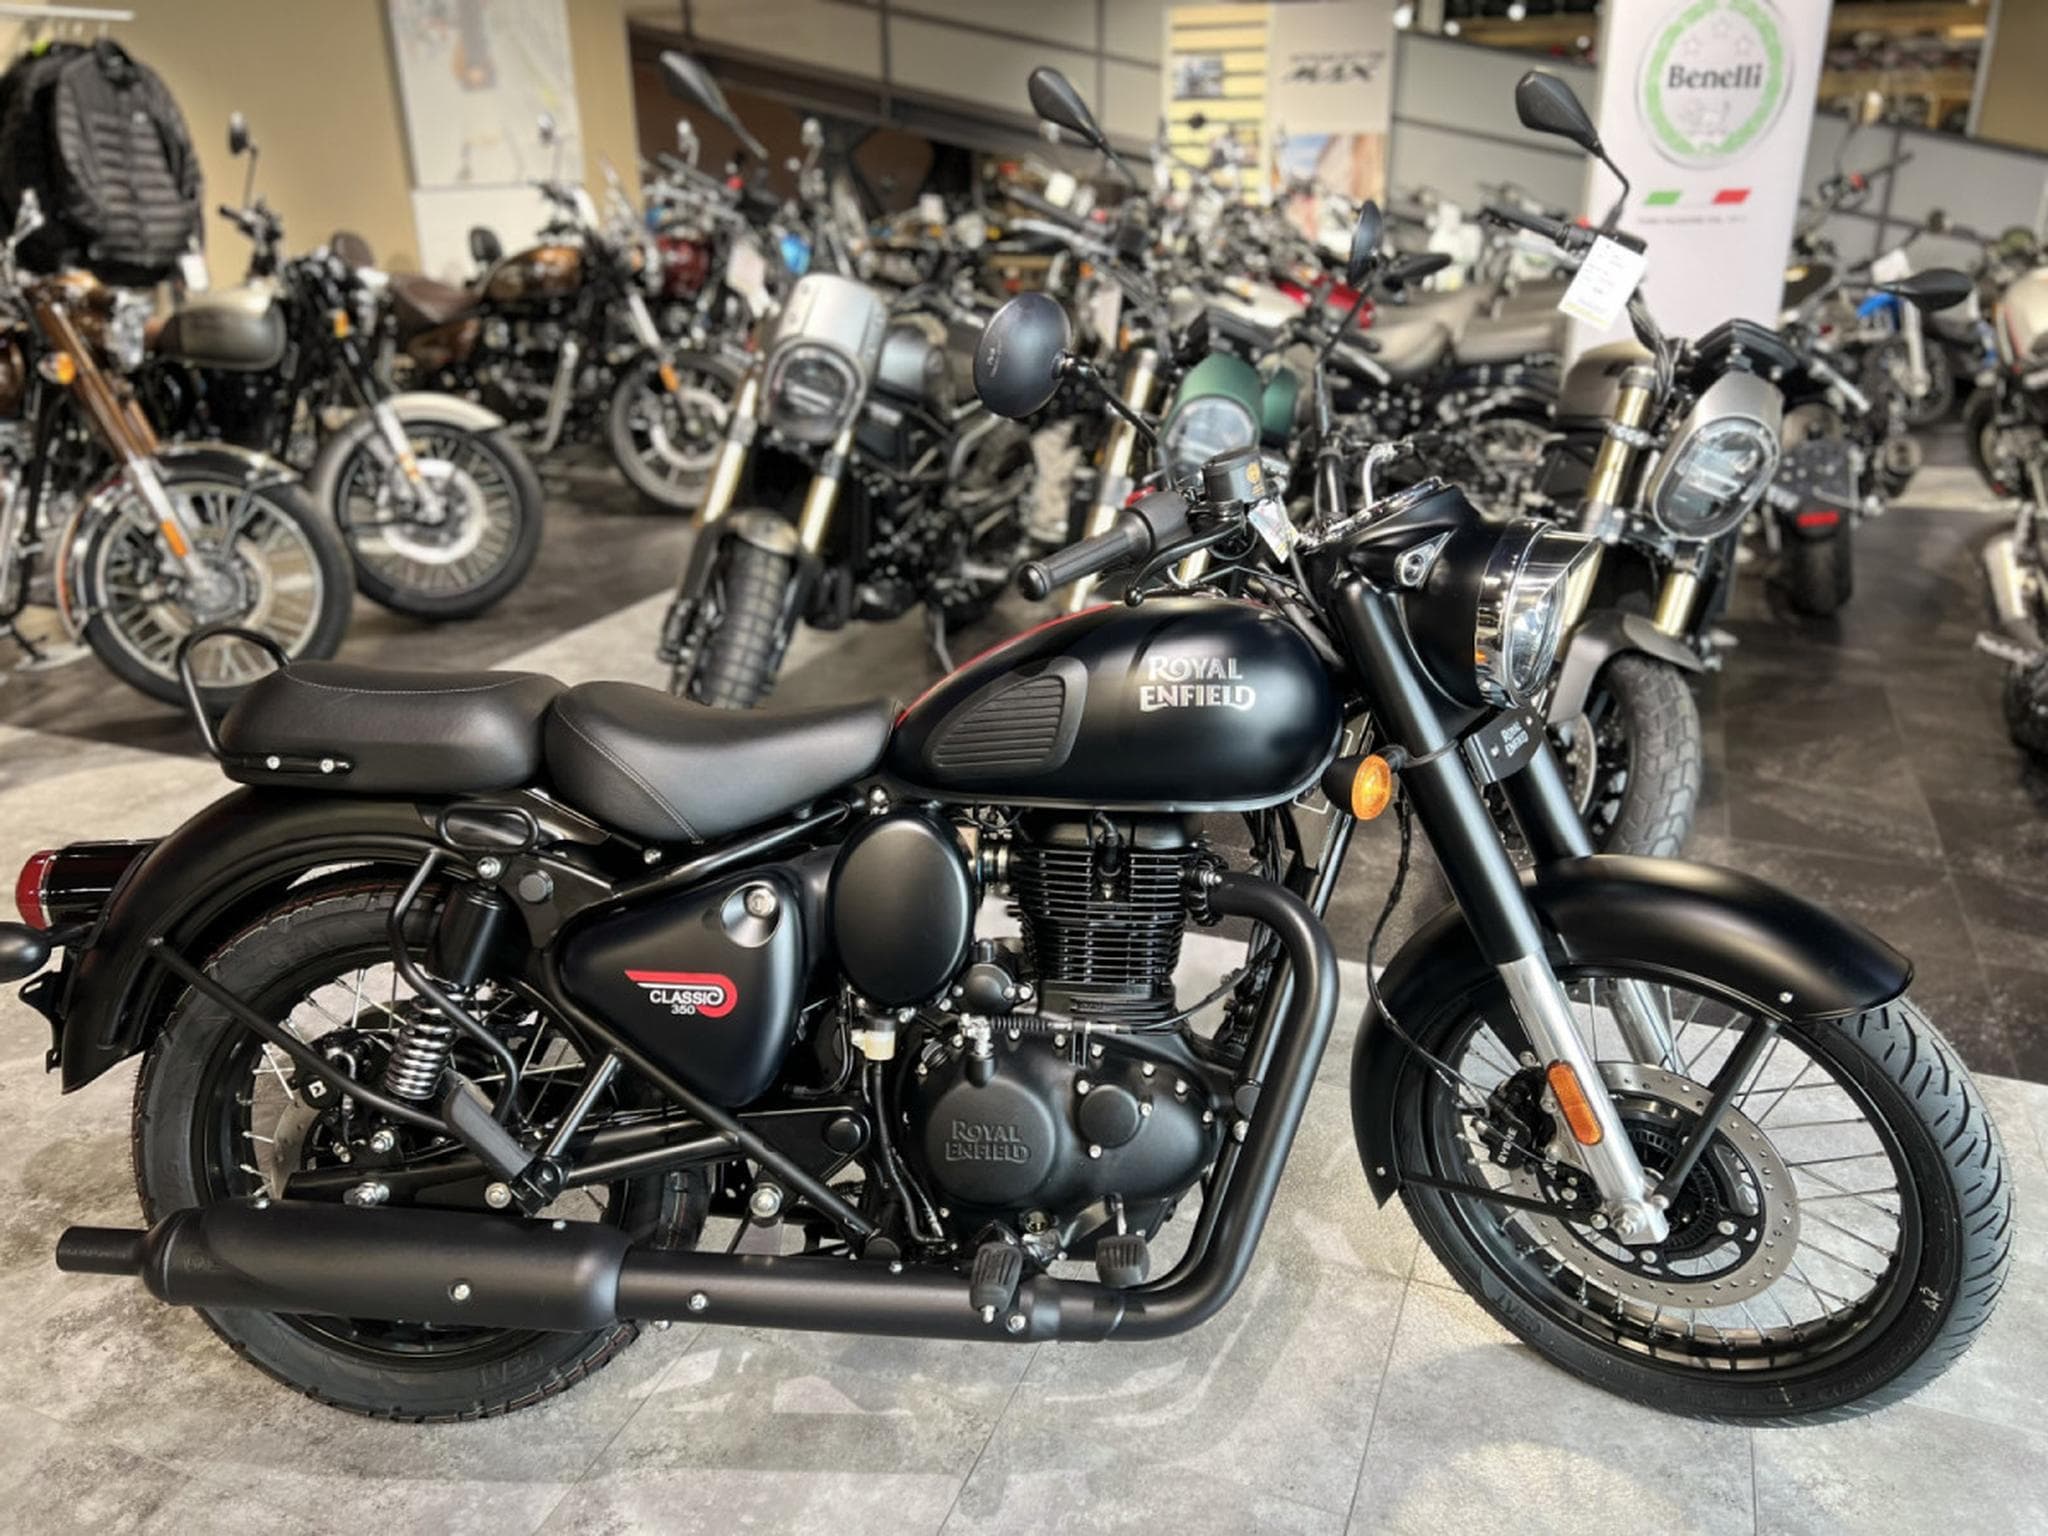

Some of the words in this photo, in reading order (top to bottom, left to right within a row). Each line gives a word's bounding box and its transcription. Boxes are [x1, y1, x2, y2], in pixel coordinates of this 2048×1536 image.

[1667, 62, 1762, 89] Benelli
[1147, 655, 1244, 683] ROYAL
[1139, 684, 1257, 713] ENFIELD
[649, 988, 724, 1006] CLASSIC
[670, 1005, 696, 1016] 350
[951, 1119, 1022, 1143] ROYAL
[944, 1140, 1032, 1165] ENFIELD
